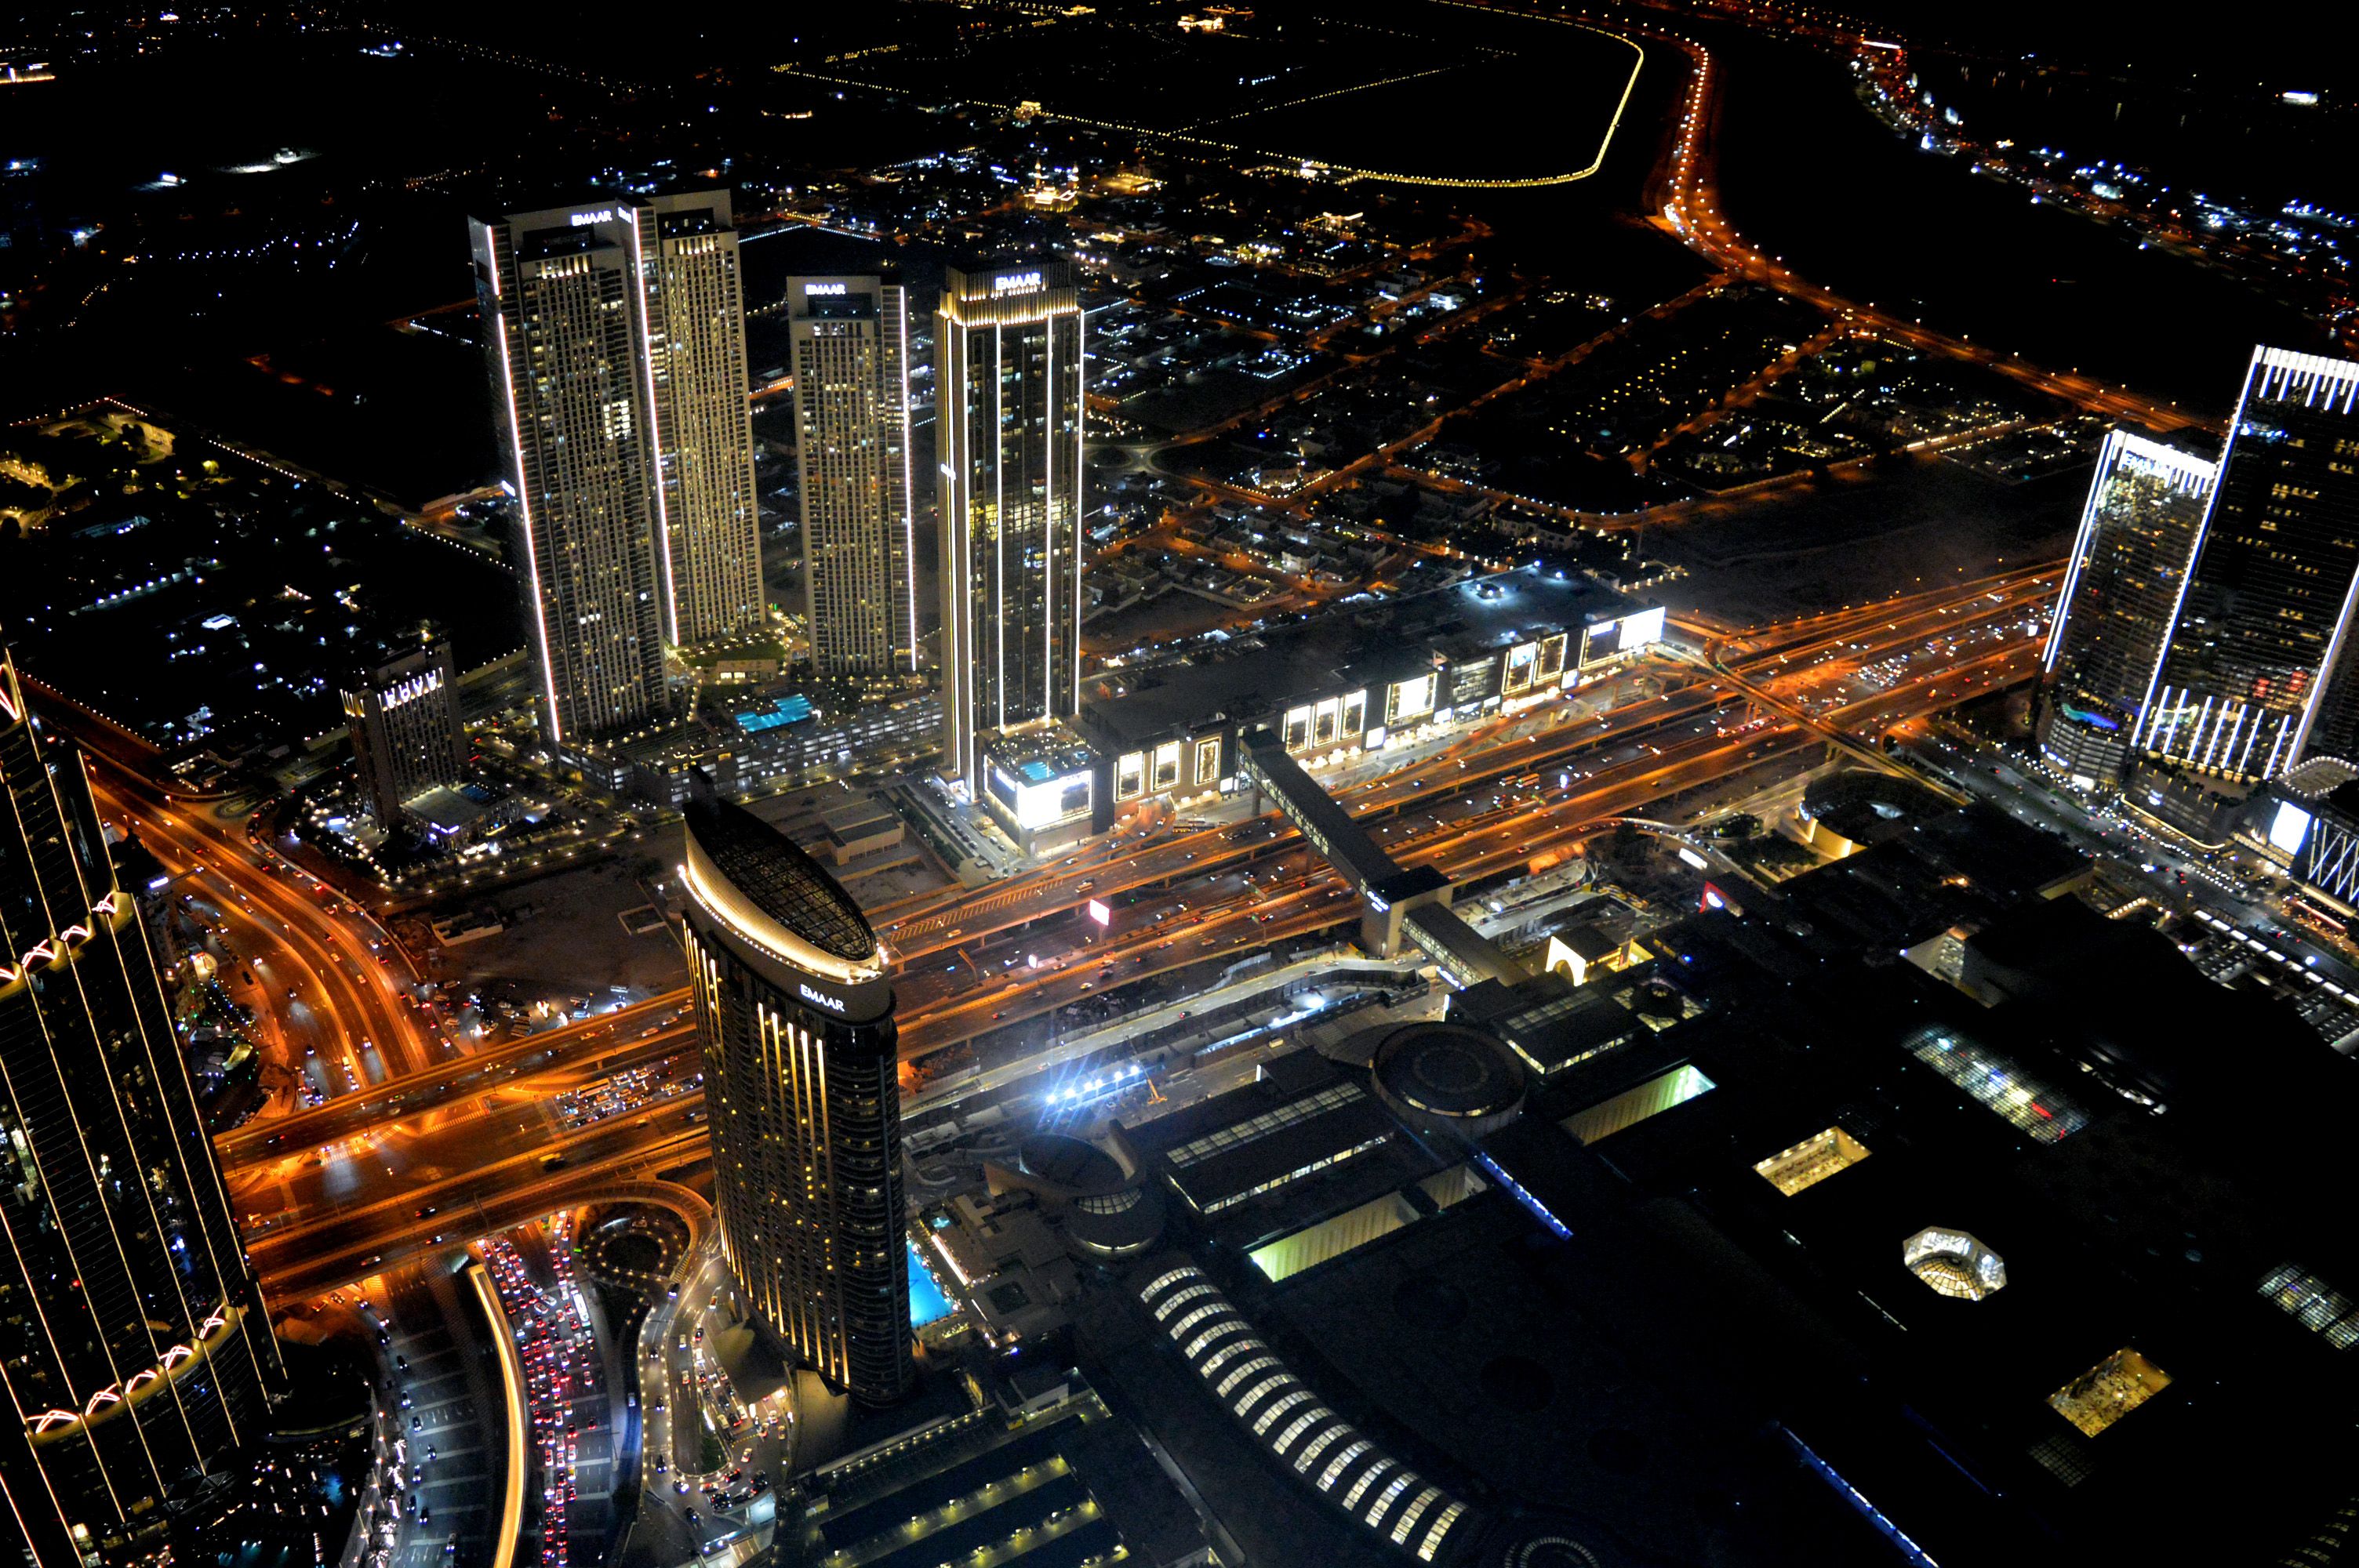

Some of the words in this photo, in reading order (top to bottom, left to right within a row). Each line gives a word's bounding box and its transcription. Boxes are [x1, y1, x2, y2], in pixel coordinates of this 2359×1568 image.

[572, 210, 612, 226] EMAAR
[805, 284, 846, 295] EMAAR
[995, 273, 1041, 290] EMAAR
[387, 677, 437, 708] ROVE
[801, 984, 845, 1011] EMAAR
